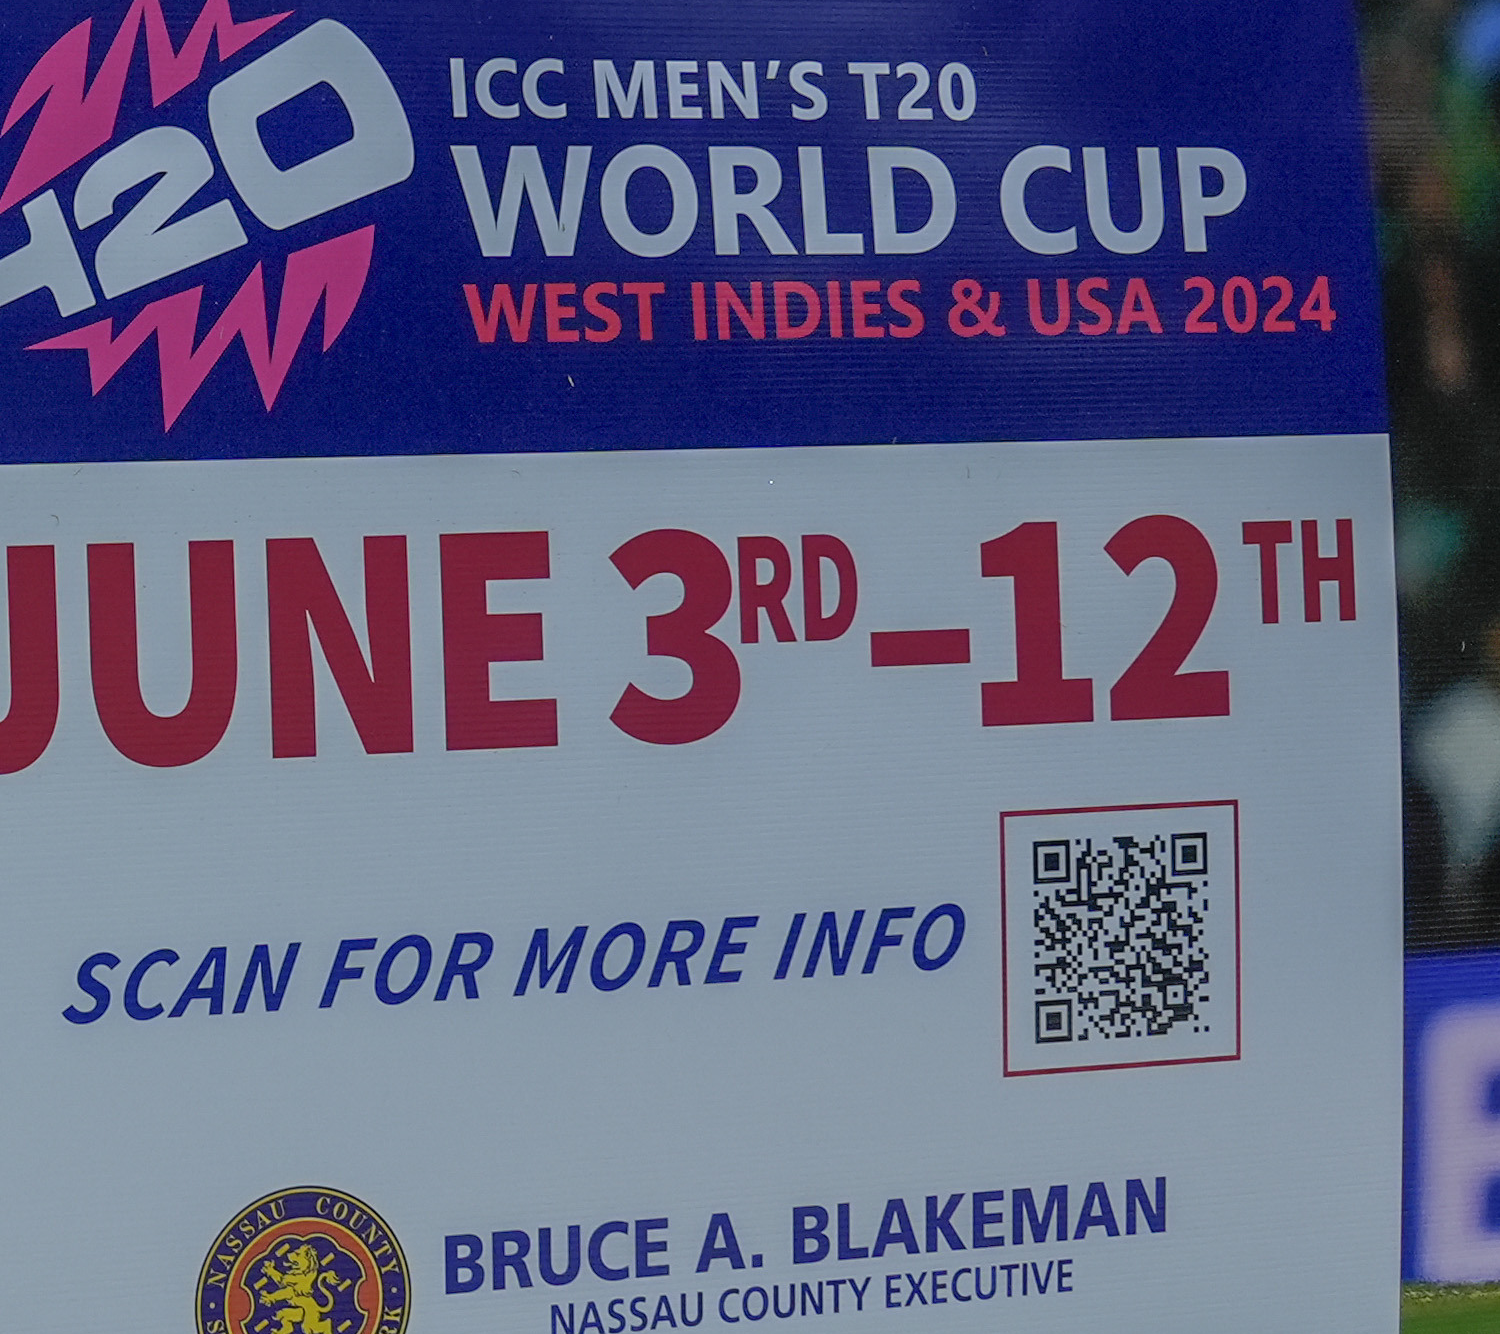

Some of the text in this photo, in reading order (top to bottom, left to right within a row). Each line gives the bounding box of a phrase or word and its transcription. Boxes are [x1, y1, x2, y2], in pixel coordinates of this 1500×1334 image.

[449, 57, 978, 122] ICC MEN'S T20
[450, 144, 1249, 259] WORLD CUP
[462, 274, 1339, 344] WEST INDIES & USA 2024
[61, 902, 967, 1026] SCAN FOR MORE INFO
[206, 1195, 401, 1289] NASSAU COUNTY
[443, 1176, 1169, 1296] BRUCE A. BLAKEMAN
[717, 1277, 872, 1326] COUNTY
[884, 1258, 1076, 1311] EXECUTIVE
